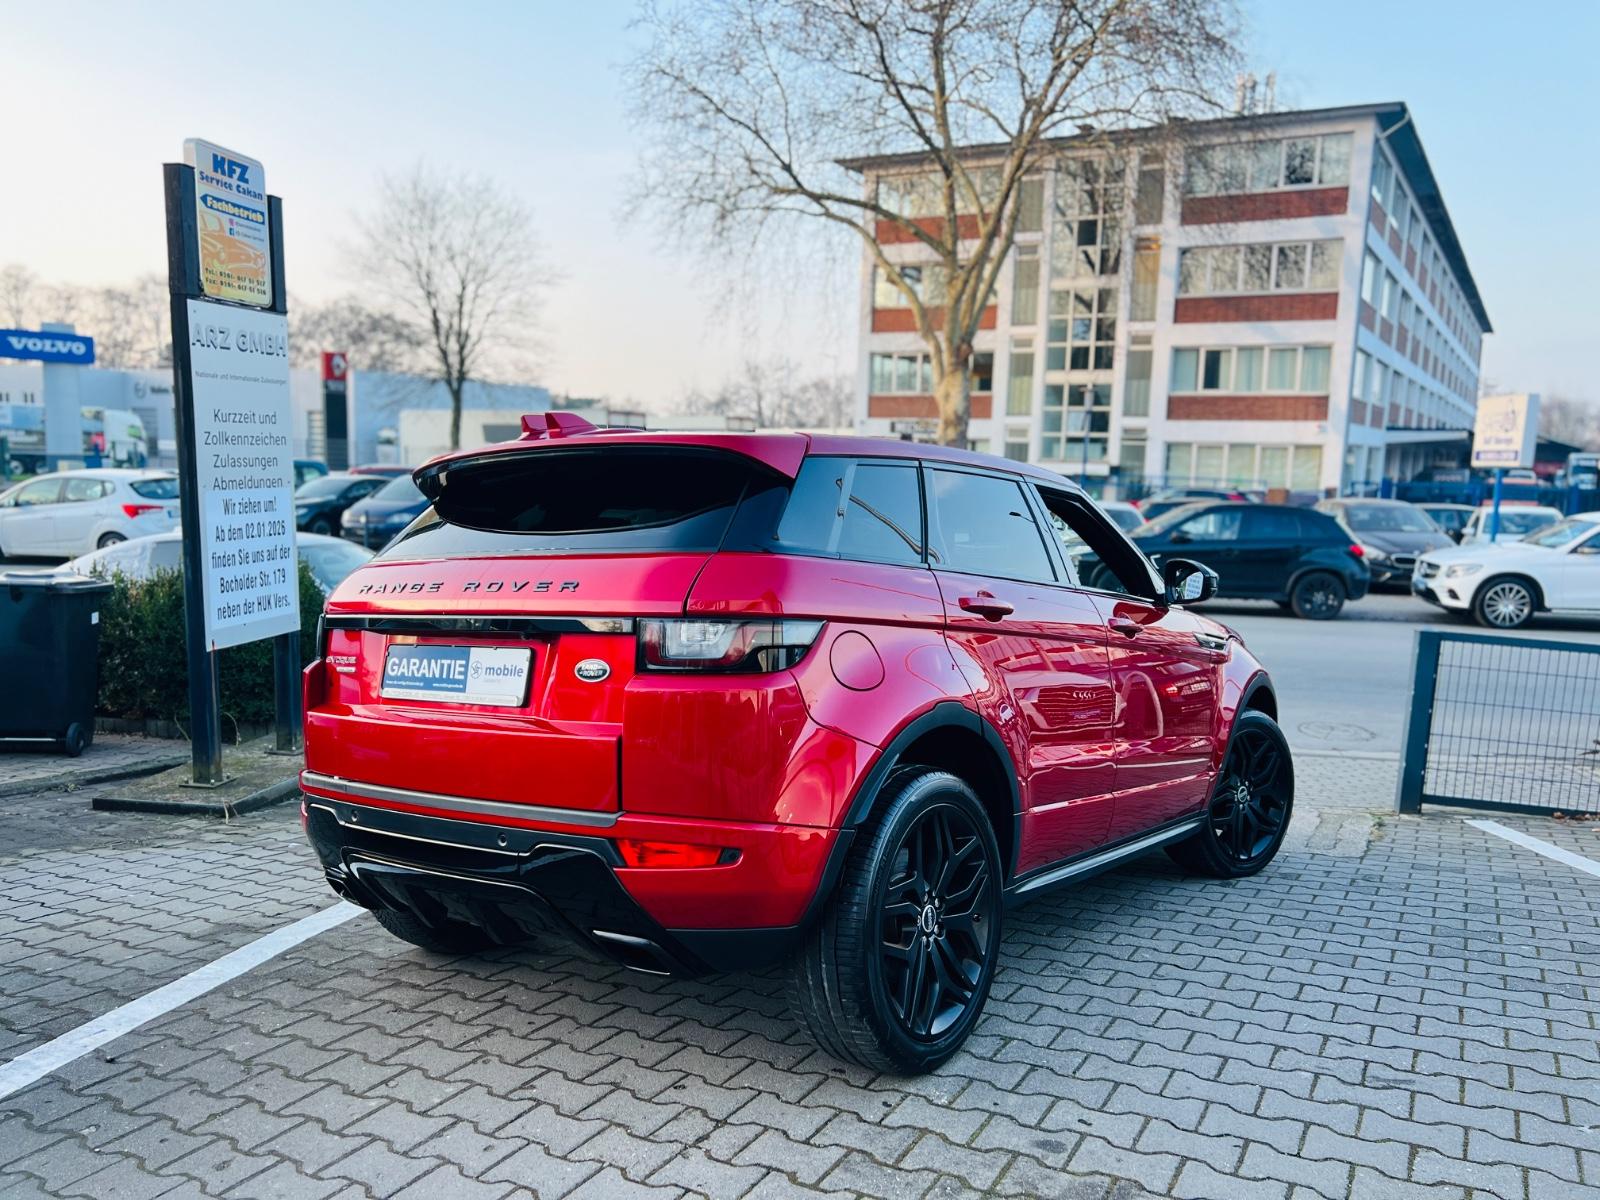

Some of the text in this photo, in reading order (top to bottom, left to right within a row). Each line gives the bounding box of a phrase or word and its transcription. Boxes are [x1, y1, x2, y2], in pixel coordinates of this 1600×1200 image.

[212, 153, 250, 184] KFZ
[199, 171, 233, 191] Service
[207, 196, 264, 222] Fachbetrieb
[6, 336, 86, 356] VOLVO
[191, 323, 286, 358] ARZ GMBH
[213, 409, 277, 425] Kurzzeit und
[204, 431, 287, 446] Zollkennzeichen
[213, 454, 278, 470] Zulassungen
[213, 476, 283, 491] Abmeldungen
[222, 496, 277, 516] Wir ziehen um!
[215, 520, 286, 542] Ab dem 02.01.2026
[211, 545, 290, 569] finden Sie uns auf der
[220, 568, 286, 594] Bocholder Str. 179
[359, 579, 580, 594] RANGE ROVER
[217, 593, 291, 620] neben der HUK Vers.
[387, 657, 524, 680] GARANTIE mobile
